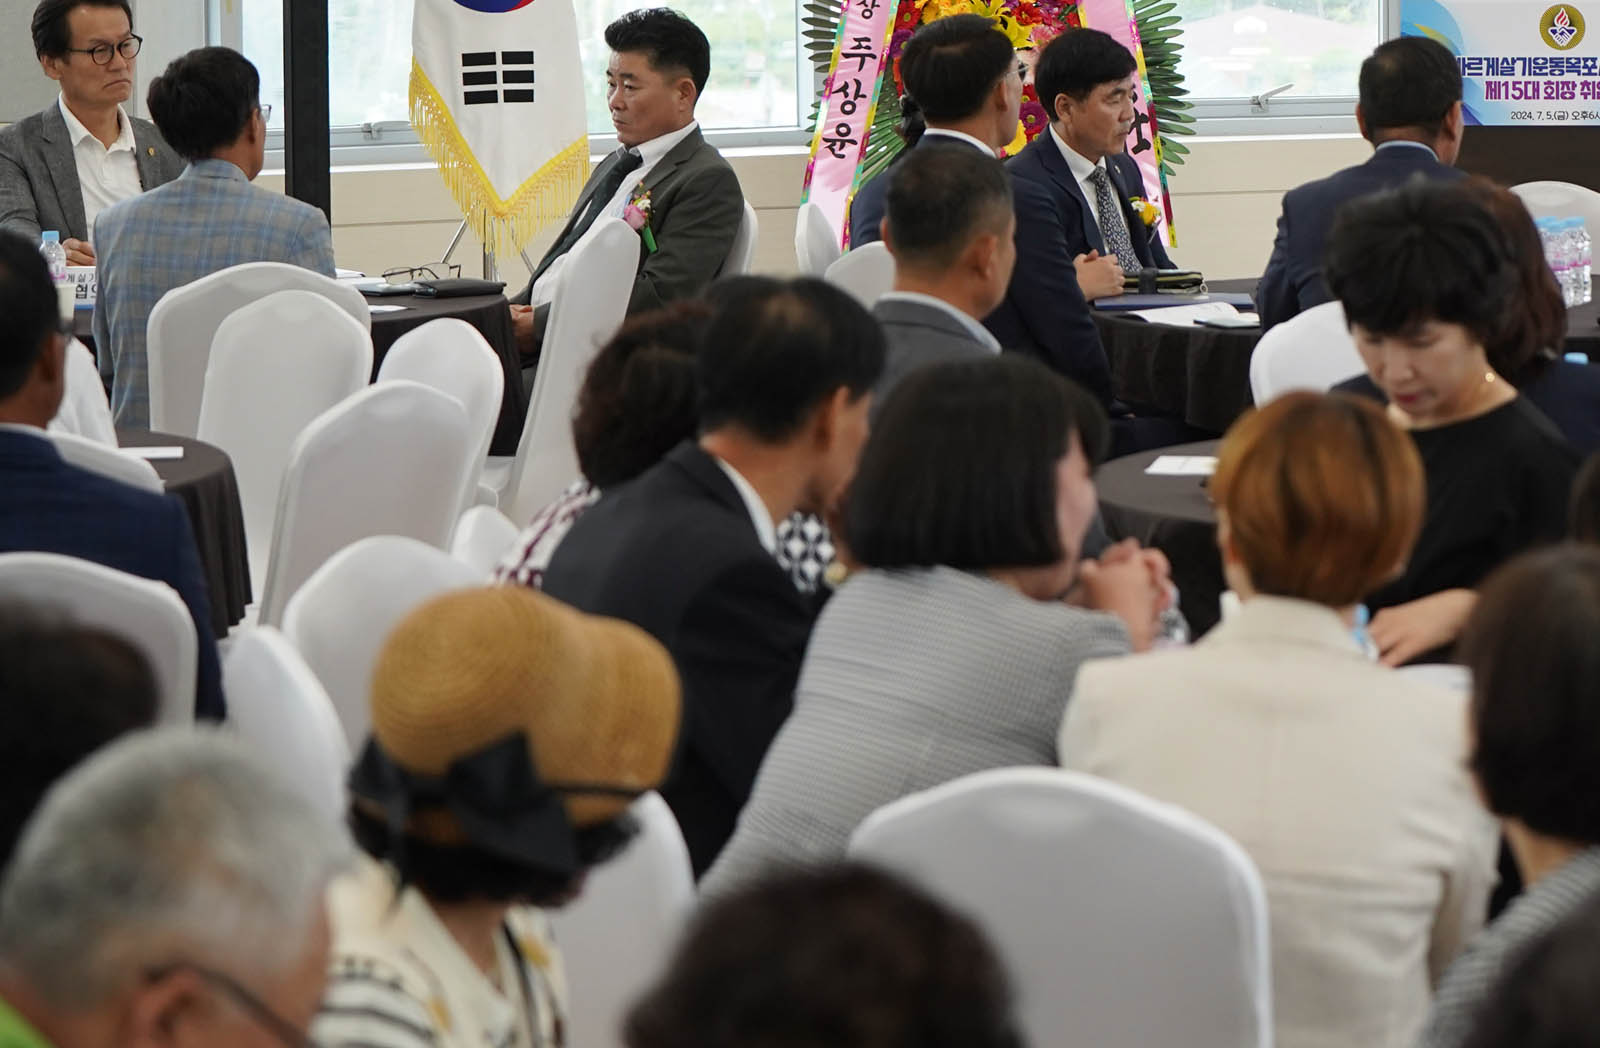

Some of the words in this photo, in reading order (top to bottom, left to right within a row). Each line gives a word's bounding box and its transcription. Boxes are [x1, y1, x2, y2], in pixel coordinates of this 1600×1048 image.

[1485, 81, 1540, 100] 제15대
[1543, 80, 1577, 100] 회장
[1511, 111, 1534, 120] 2024.
